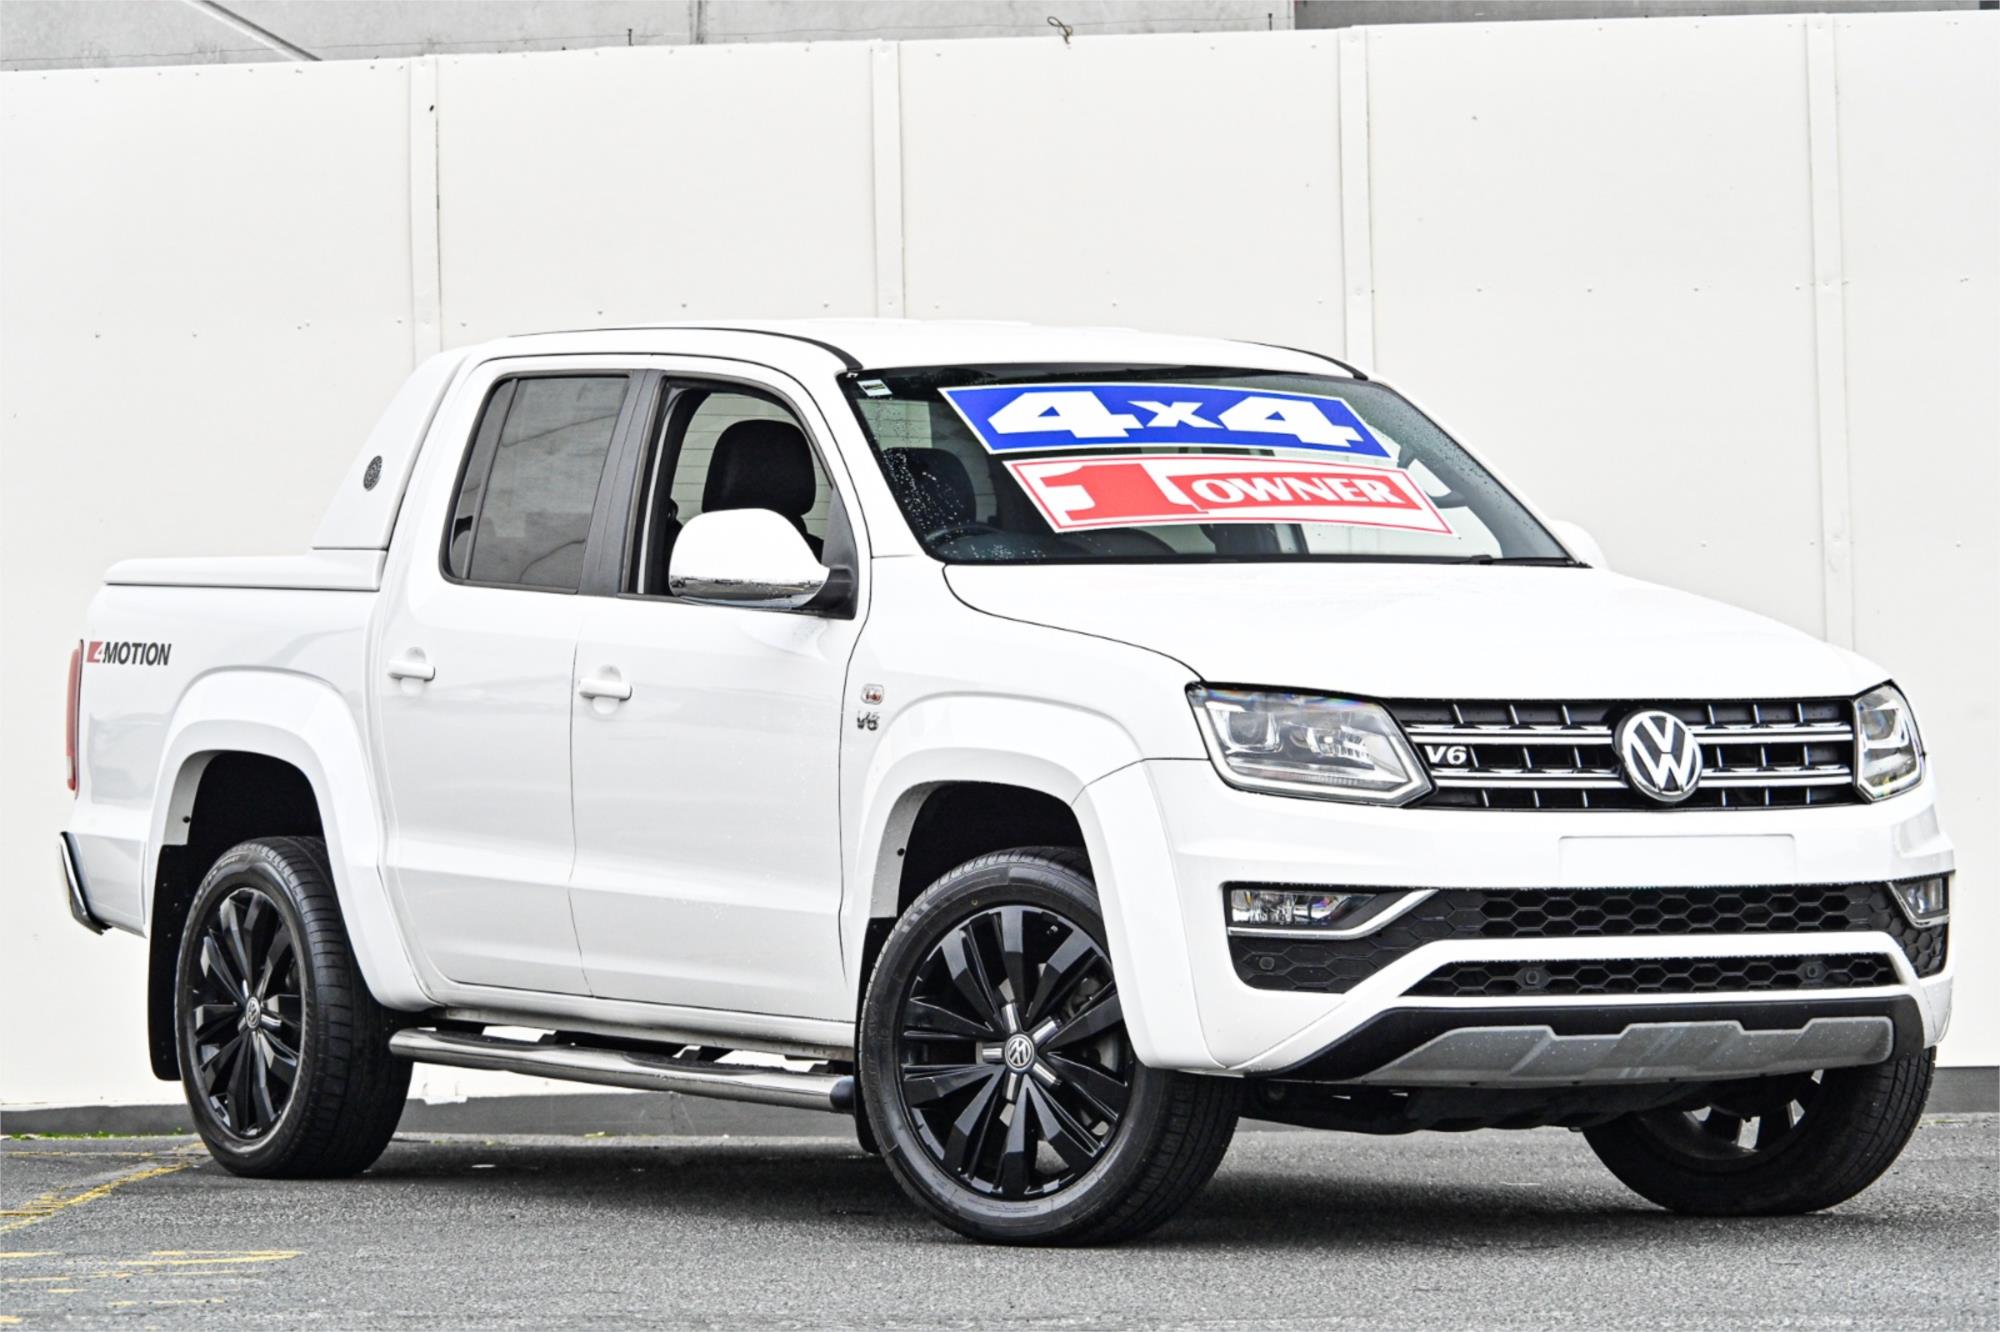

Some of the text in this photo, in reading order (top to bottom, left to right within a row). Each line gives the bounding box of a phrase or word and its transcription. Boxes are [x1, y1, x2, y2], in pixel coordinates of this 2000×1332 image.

[1039, 463, 1406, 521] 1 OWNER
[87, 641, 172, 666] 4MOTION
[1424, 745, 1467, 765] V6
[1621, 710, 1702, 797] VW
